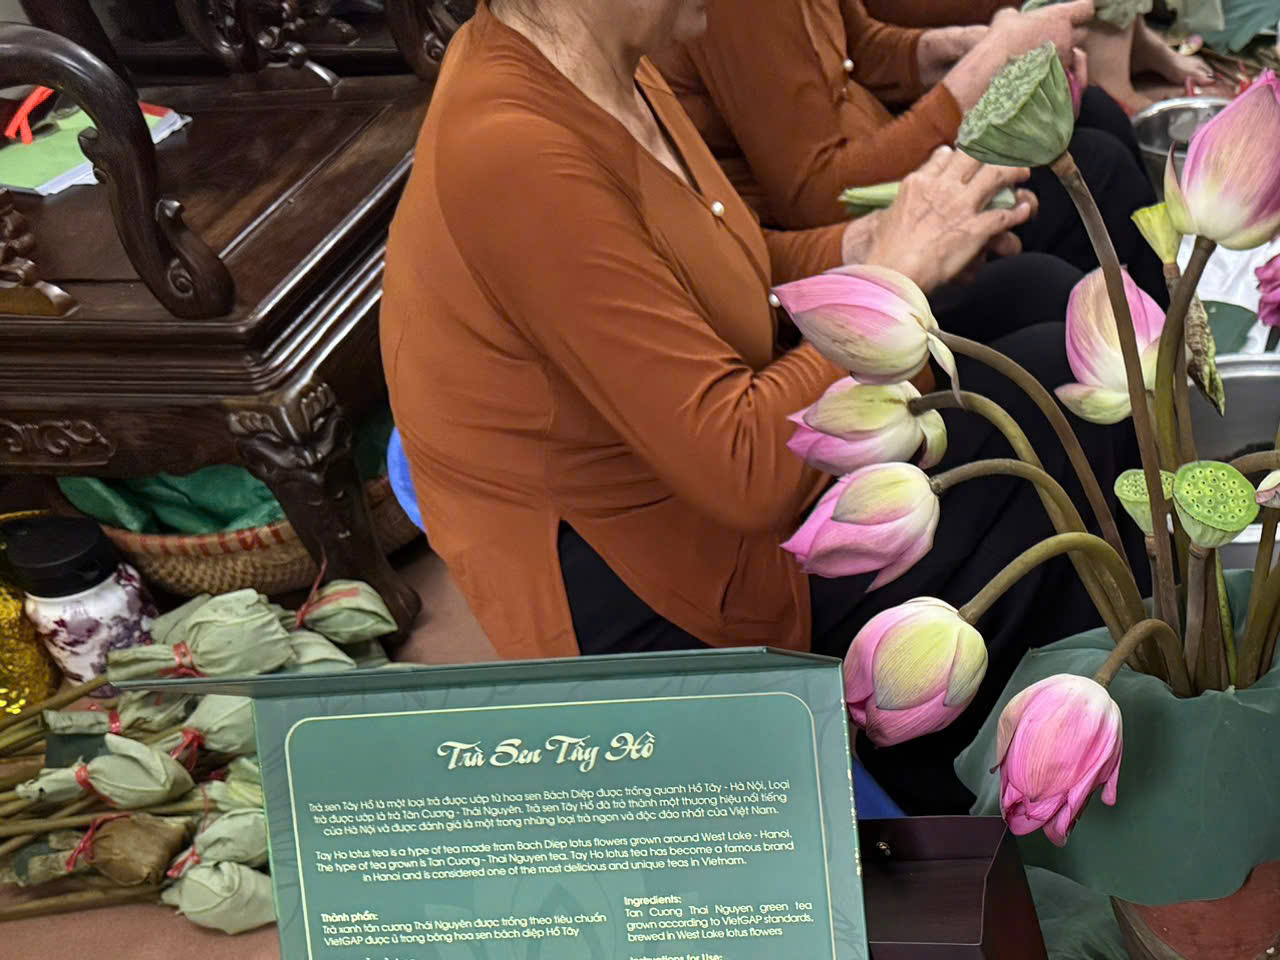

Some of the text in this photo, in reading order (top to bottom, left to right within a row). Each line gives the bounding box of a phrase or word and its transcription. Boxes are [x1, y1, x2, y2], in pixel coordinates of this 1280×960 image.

[437, 740, 486, 770] Trà
[489, 738, 542, 766] Sen
[569, 831, 752, 847] lotus flowers grown around West Lake
[372, 871, 401, 881] Hanoi
[402, 871, 422, 880] and
[431, 867, 485, 878] considered
[486, 868, 506, 876] one
[520, 866, 536, 874] the
[537, 864, 562, 873] most
[563, 862, 607, 872] delicious
[608, 861, 629, 870] and
[630, 860, 665, 870] unique
[667, 859, 689, 867] teas
[624, 894, 681, 907] Ingredients:
[624, 909, 643, 917] Tan
[689, 905, 708, 914] Thai
[715, 904, 753, 916] Nguyen
[759, 904, 789, 914] green
[795, 901, 812, 910] tea
[626, 921, 657, 931] grown
[658, 916, 708, 928] according
[721, 914, 762, 925] VietGAP
[627, 930, 665, 941] brewed
[676, 930, 699, 939] West
[701, 929, 724, 938] Lake
[725, 928, 748, 937] lotus
[749, 927, 783, 936] flowers
